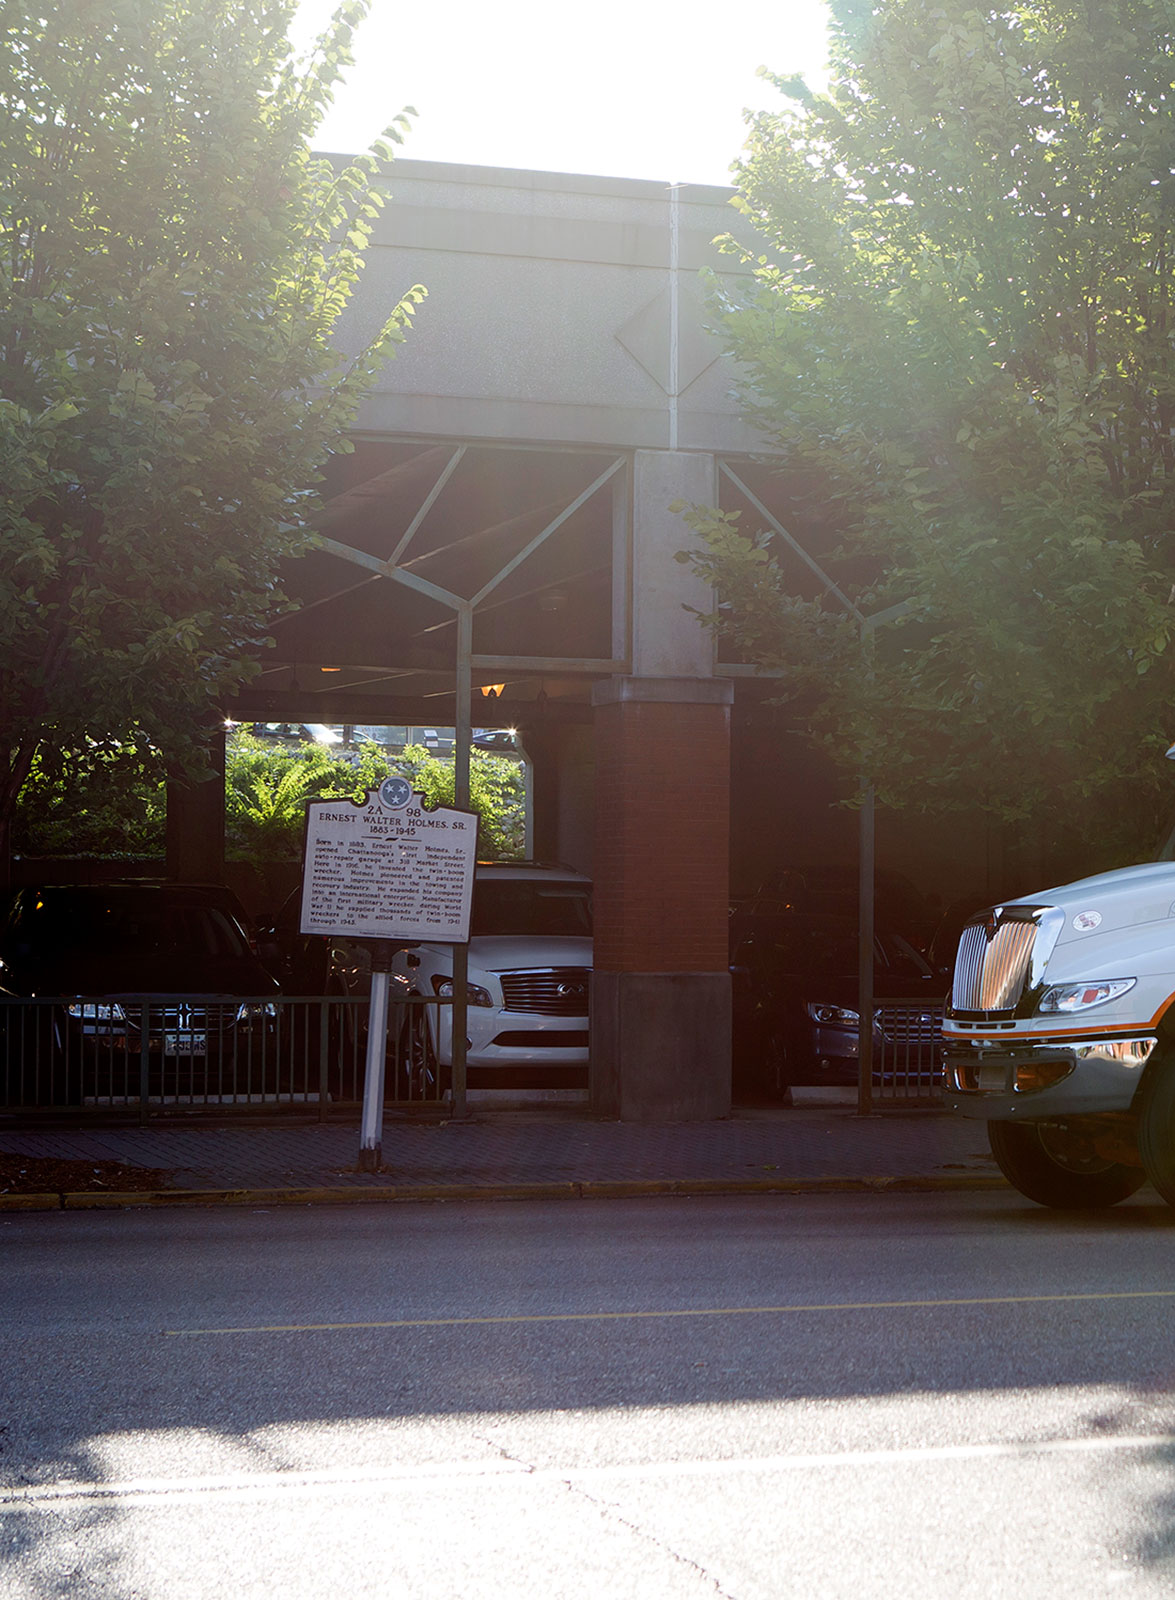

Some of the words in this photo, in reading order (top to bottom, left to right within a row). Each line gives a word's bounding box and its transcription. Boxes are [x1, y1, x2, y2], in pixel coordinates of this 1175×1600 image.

[367, 805, 383, 815] 2A
[406, 808, 421, 818] 98
[320, 813, 357, 822] ERNEST
[363, 816, 401, 826] WALTER
[452, 821, 467, 830] SR.
